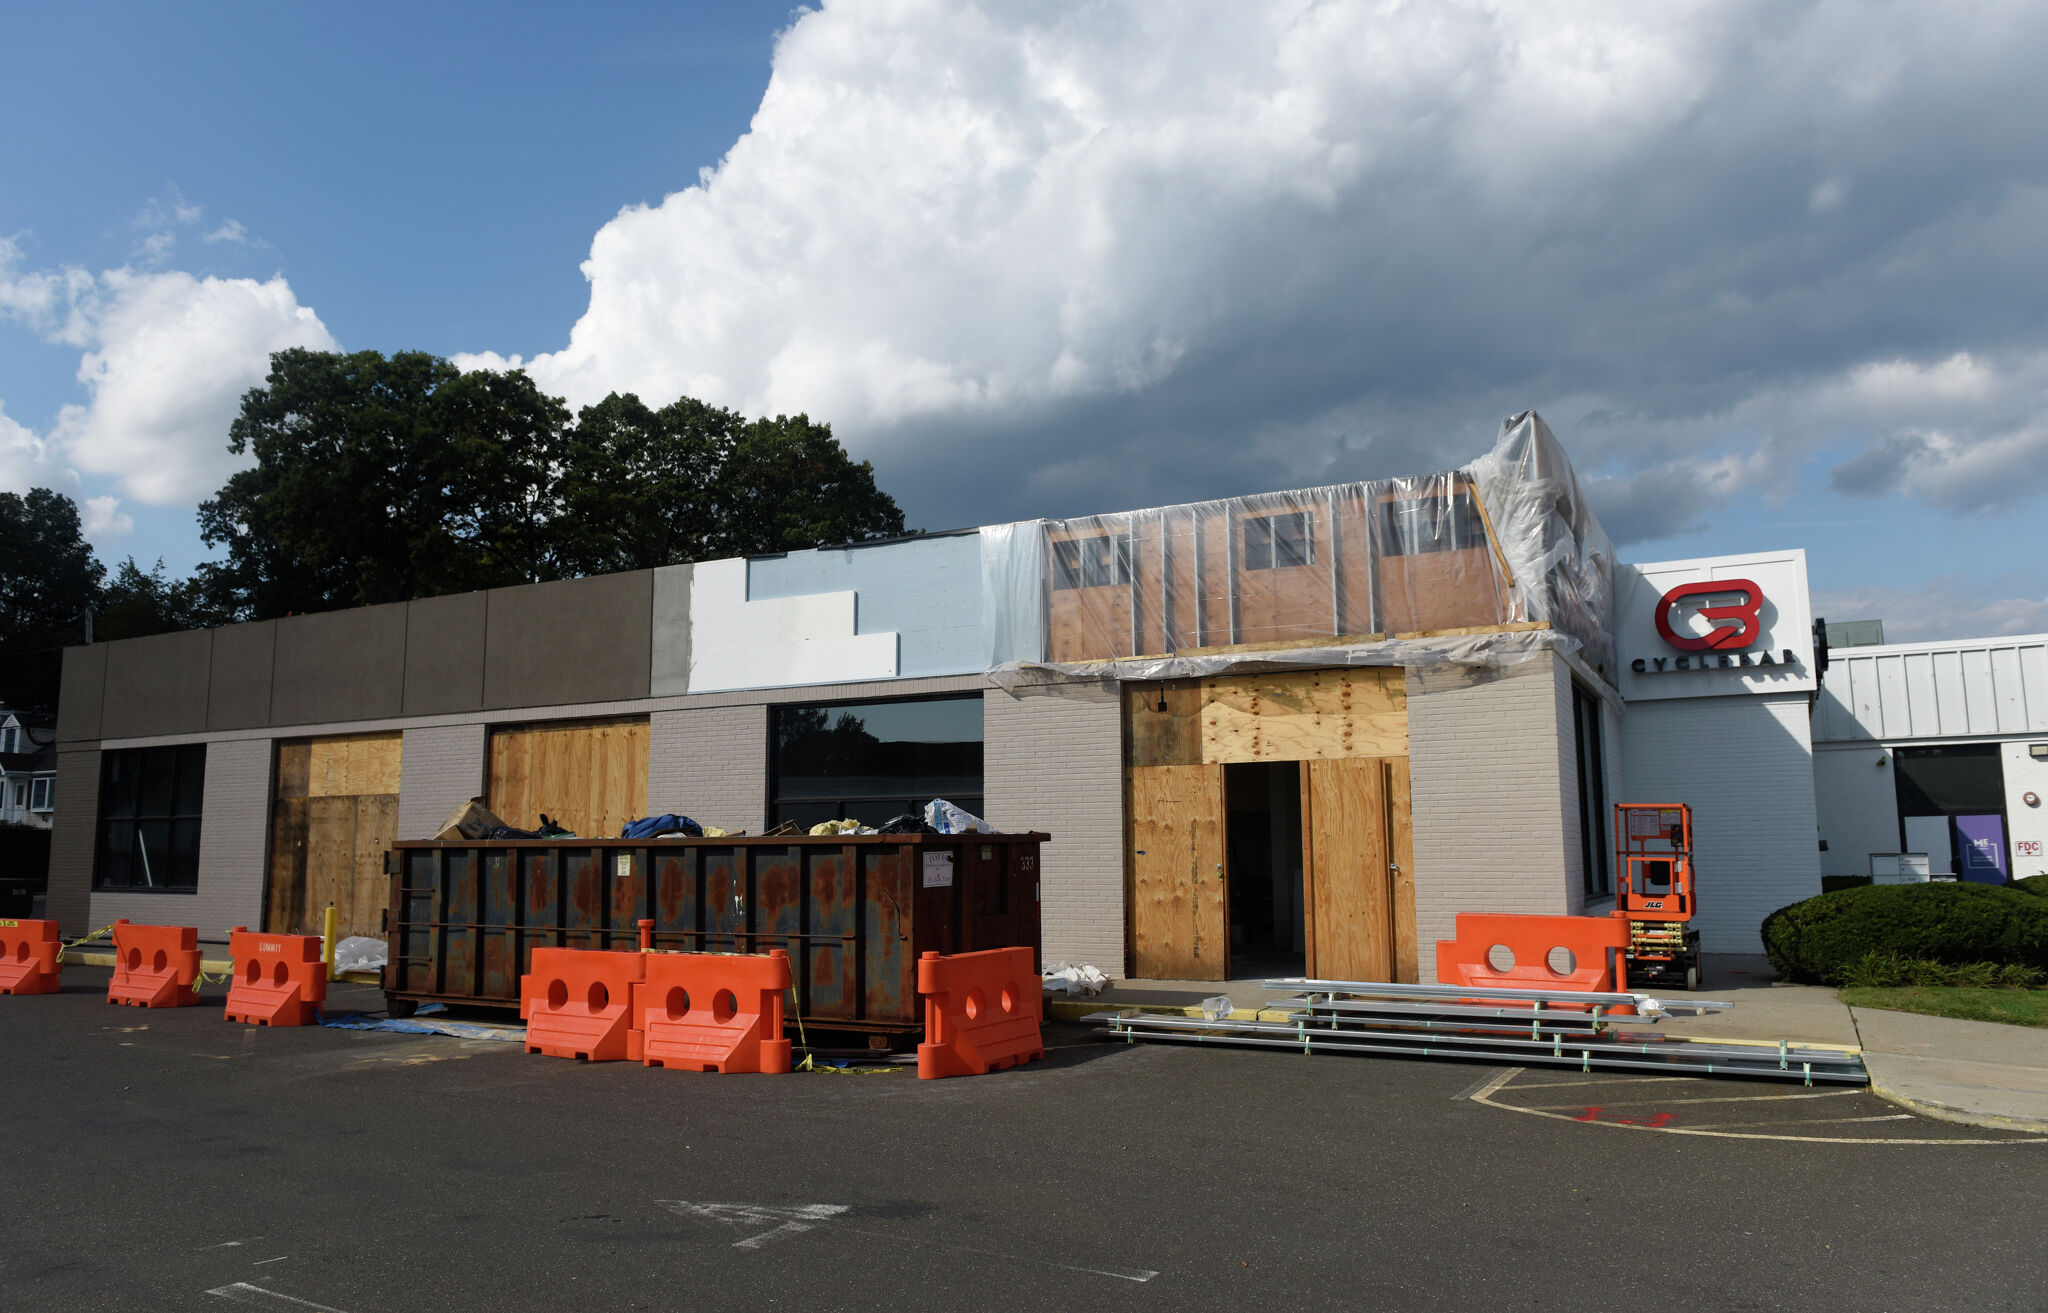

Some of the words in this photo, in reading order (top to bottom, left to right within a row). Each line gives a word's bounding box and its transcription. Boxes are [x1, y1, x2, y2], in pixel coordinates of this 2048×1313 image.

[1631, 649, 1796, 673] CYCLEBAR
[2018, 842, 2038, 851] FDC
[259, 942, 281, 952] SUMMIT
